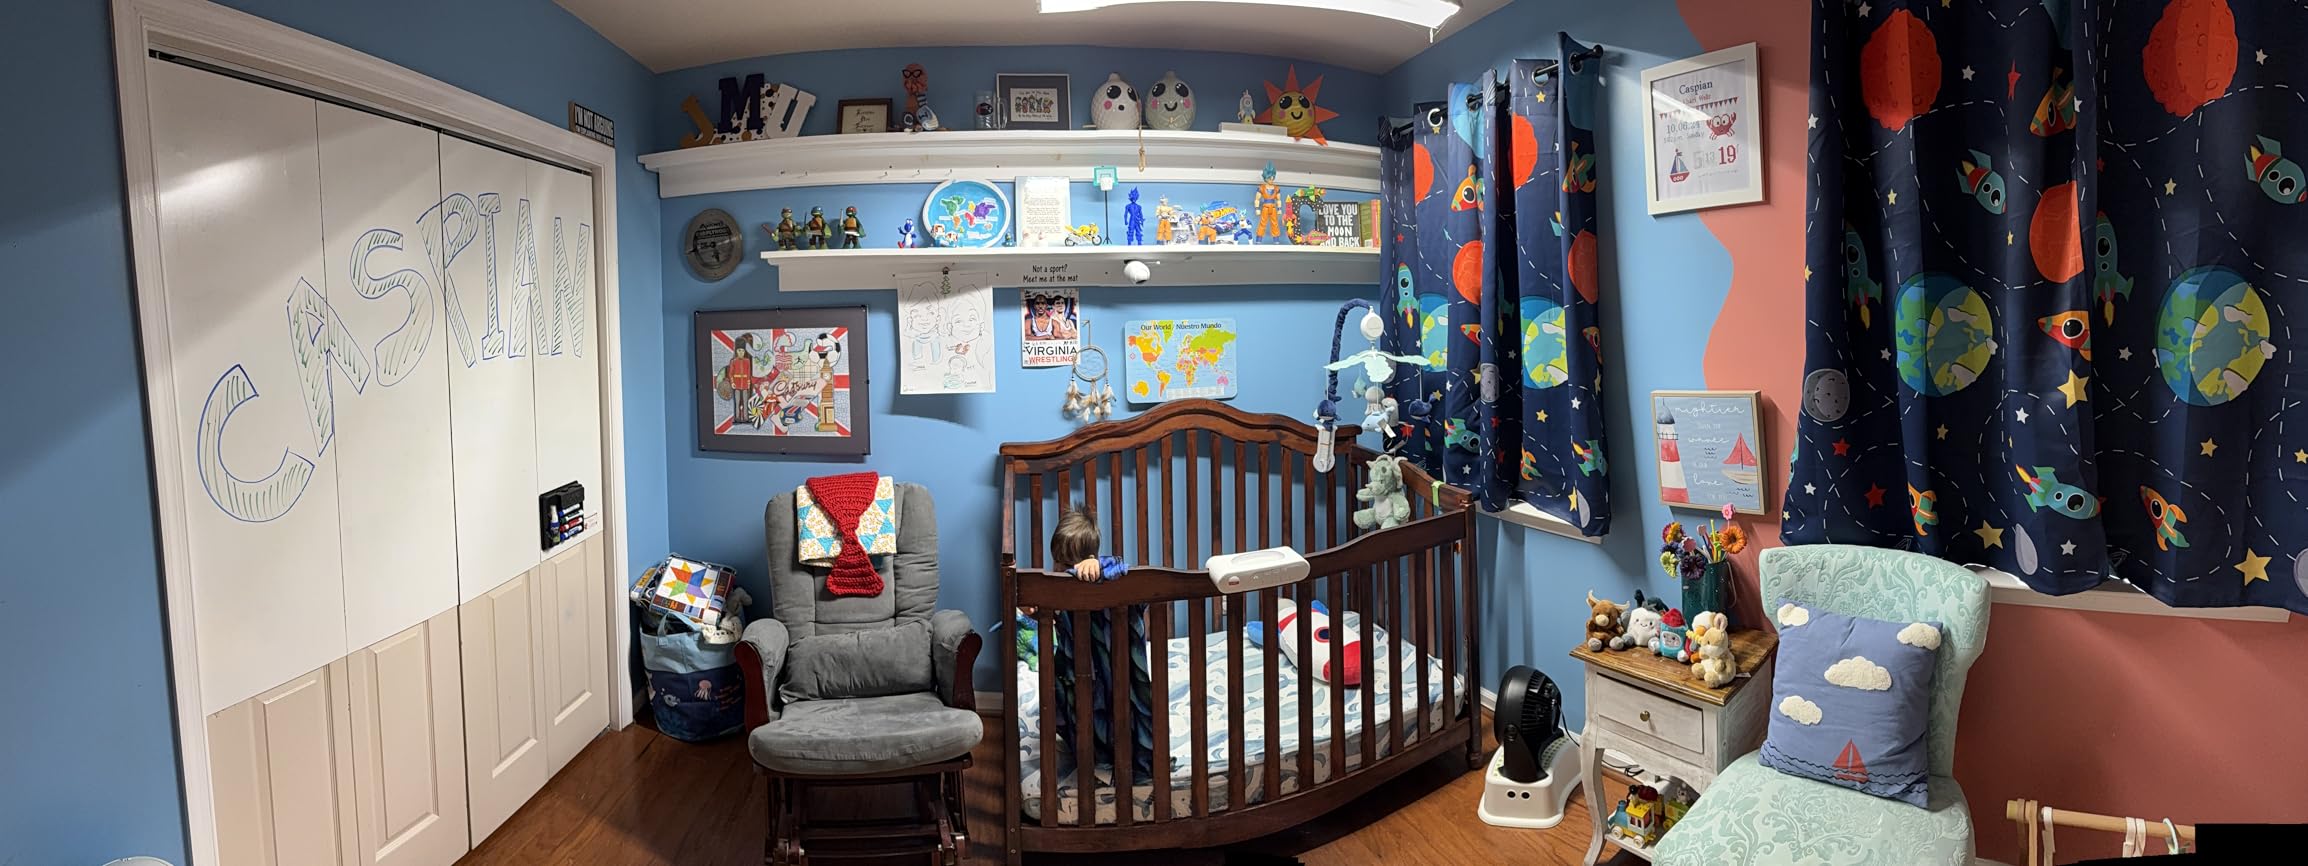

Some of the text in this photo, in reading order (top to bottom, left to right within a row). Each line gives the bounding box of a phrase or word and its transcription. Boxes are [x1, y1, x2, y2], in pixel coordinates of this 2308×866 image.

[1679, 81, 1713, 95] Caspian
[1341, 204, 1358, 215] YOU
[1323, 215, 1354, 226] TO THE
[1327, 226, 1353, 237] MOON
[1338, 237, 1360, 247] BACK
[1032, 264, 1043, 273] Not
[1049, 264, 1068, 275] sport?
[1023, 275, 1038, 283] Meet
[1050, 275, 1055, 283] at
[1056, 274, 1066, 282] the
[1024, 346, 1077, 356] VIRGINIA
[197, 191, 591, 523] CASPIAN
[1029, 355, 1074, 363] WRESTLING
[1693, 472, 1724, 486] love
